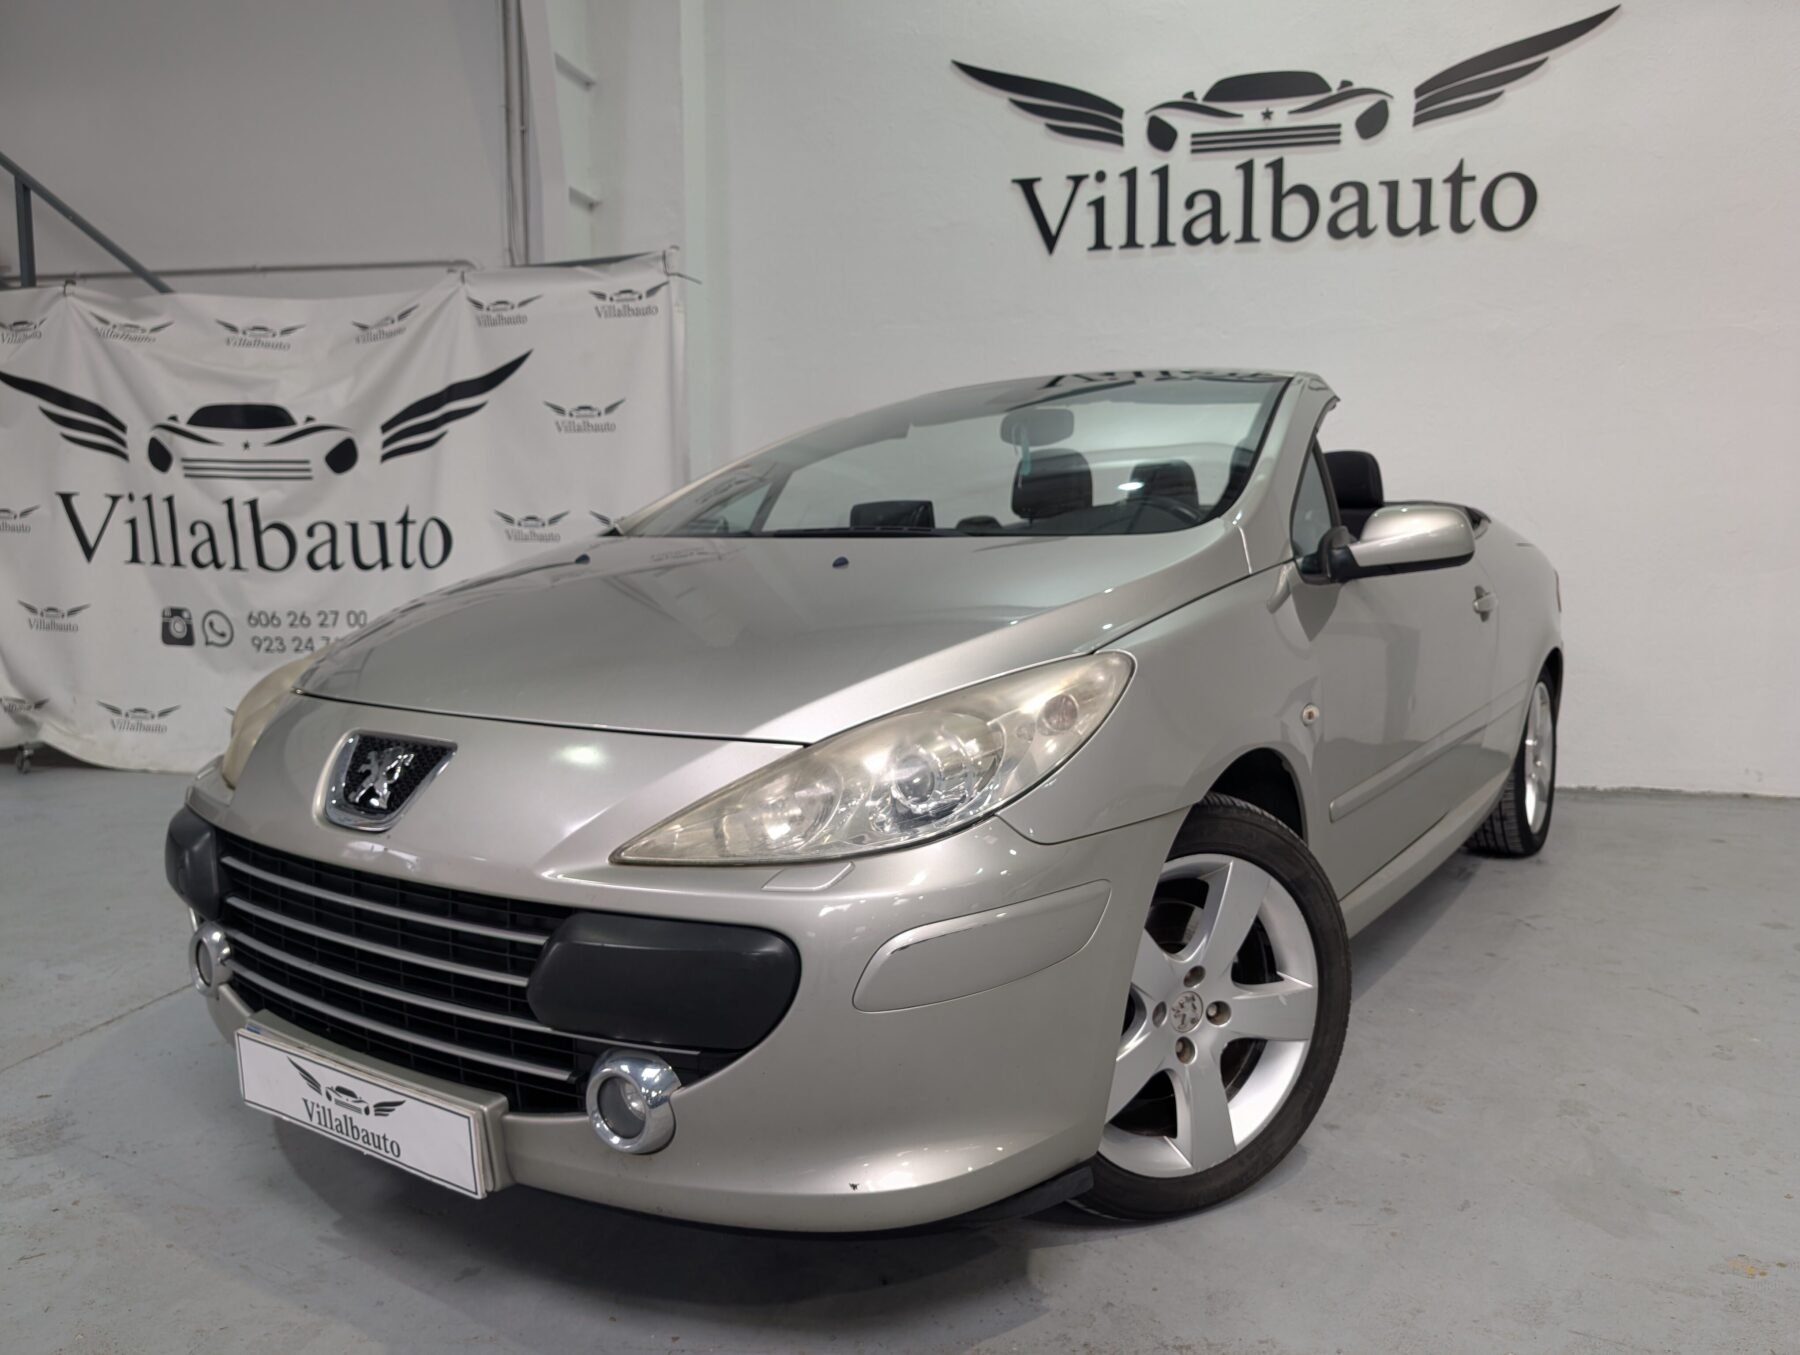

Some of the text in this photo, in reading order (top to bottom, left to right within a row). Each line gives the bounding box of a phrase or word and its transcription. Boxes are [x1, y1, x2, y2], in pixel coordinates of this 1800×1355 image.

[1010, 157, 1539, 255] Villalbauto
[593, 304, 659, 319] Villalbauto
[475, 312, 528, 328] Villalbauto
[223, 336, 291, 351] Villalbauto
[554, 421, 616, 434] Villalbauto
[0, 519, 31, 533] lbauto
[55, 491, 453, 573] Villalbauto
[504, 529, 561, 543] Villalbauto
[27, 618, 79, 632] Villalbauto
[247, 610, 368, 629] 606 26 27 00
[251, 635, 287, 653] 923
[291, 636, 315, 653] 24
[109, 718, 168, 734] Villalbauto
[302, 1097, 401, 1158] Villalbauto
